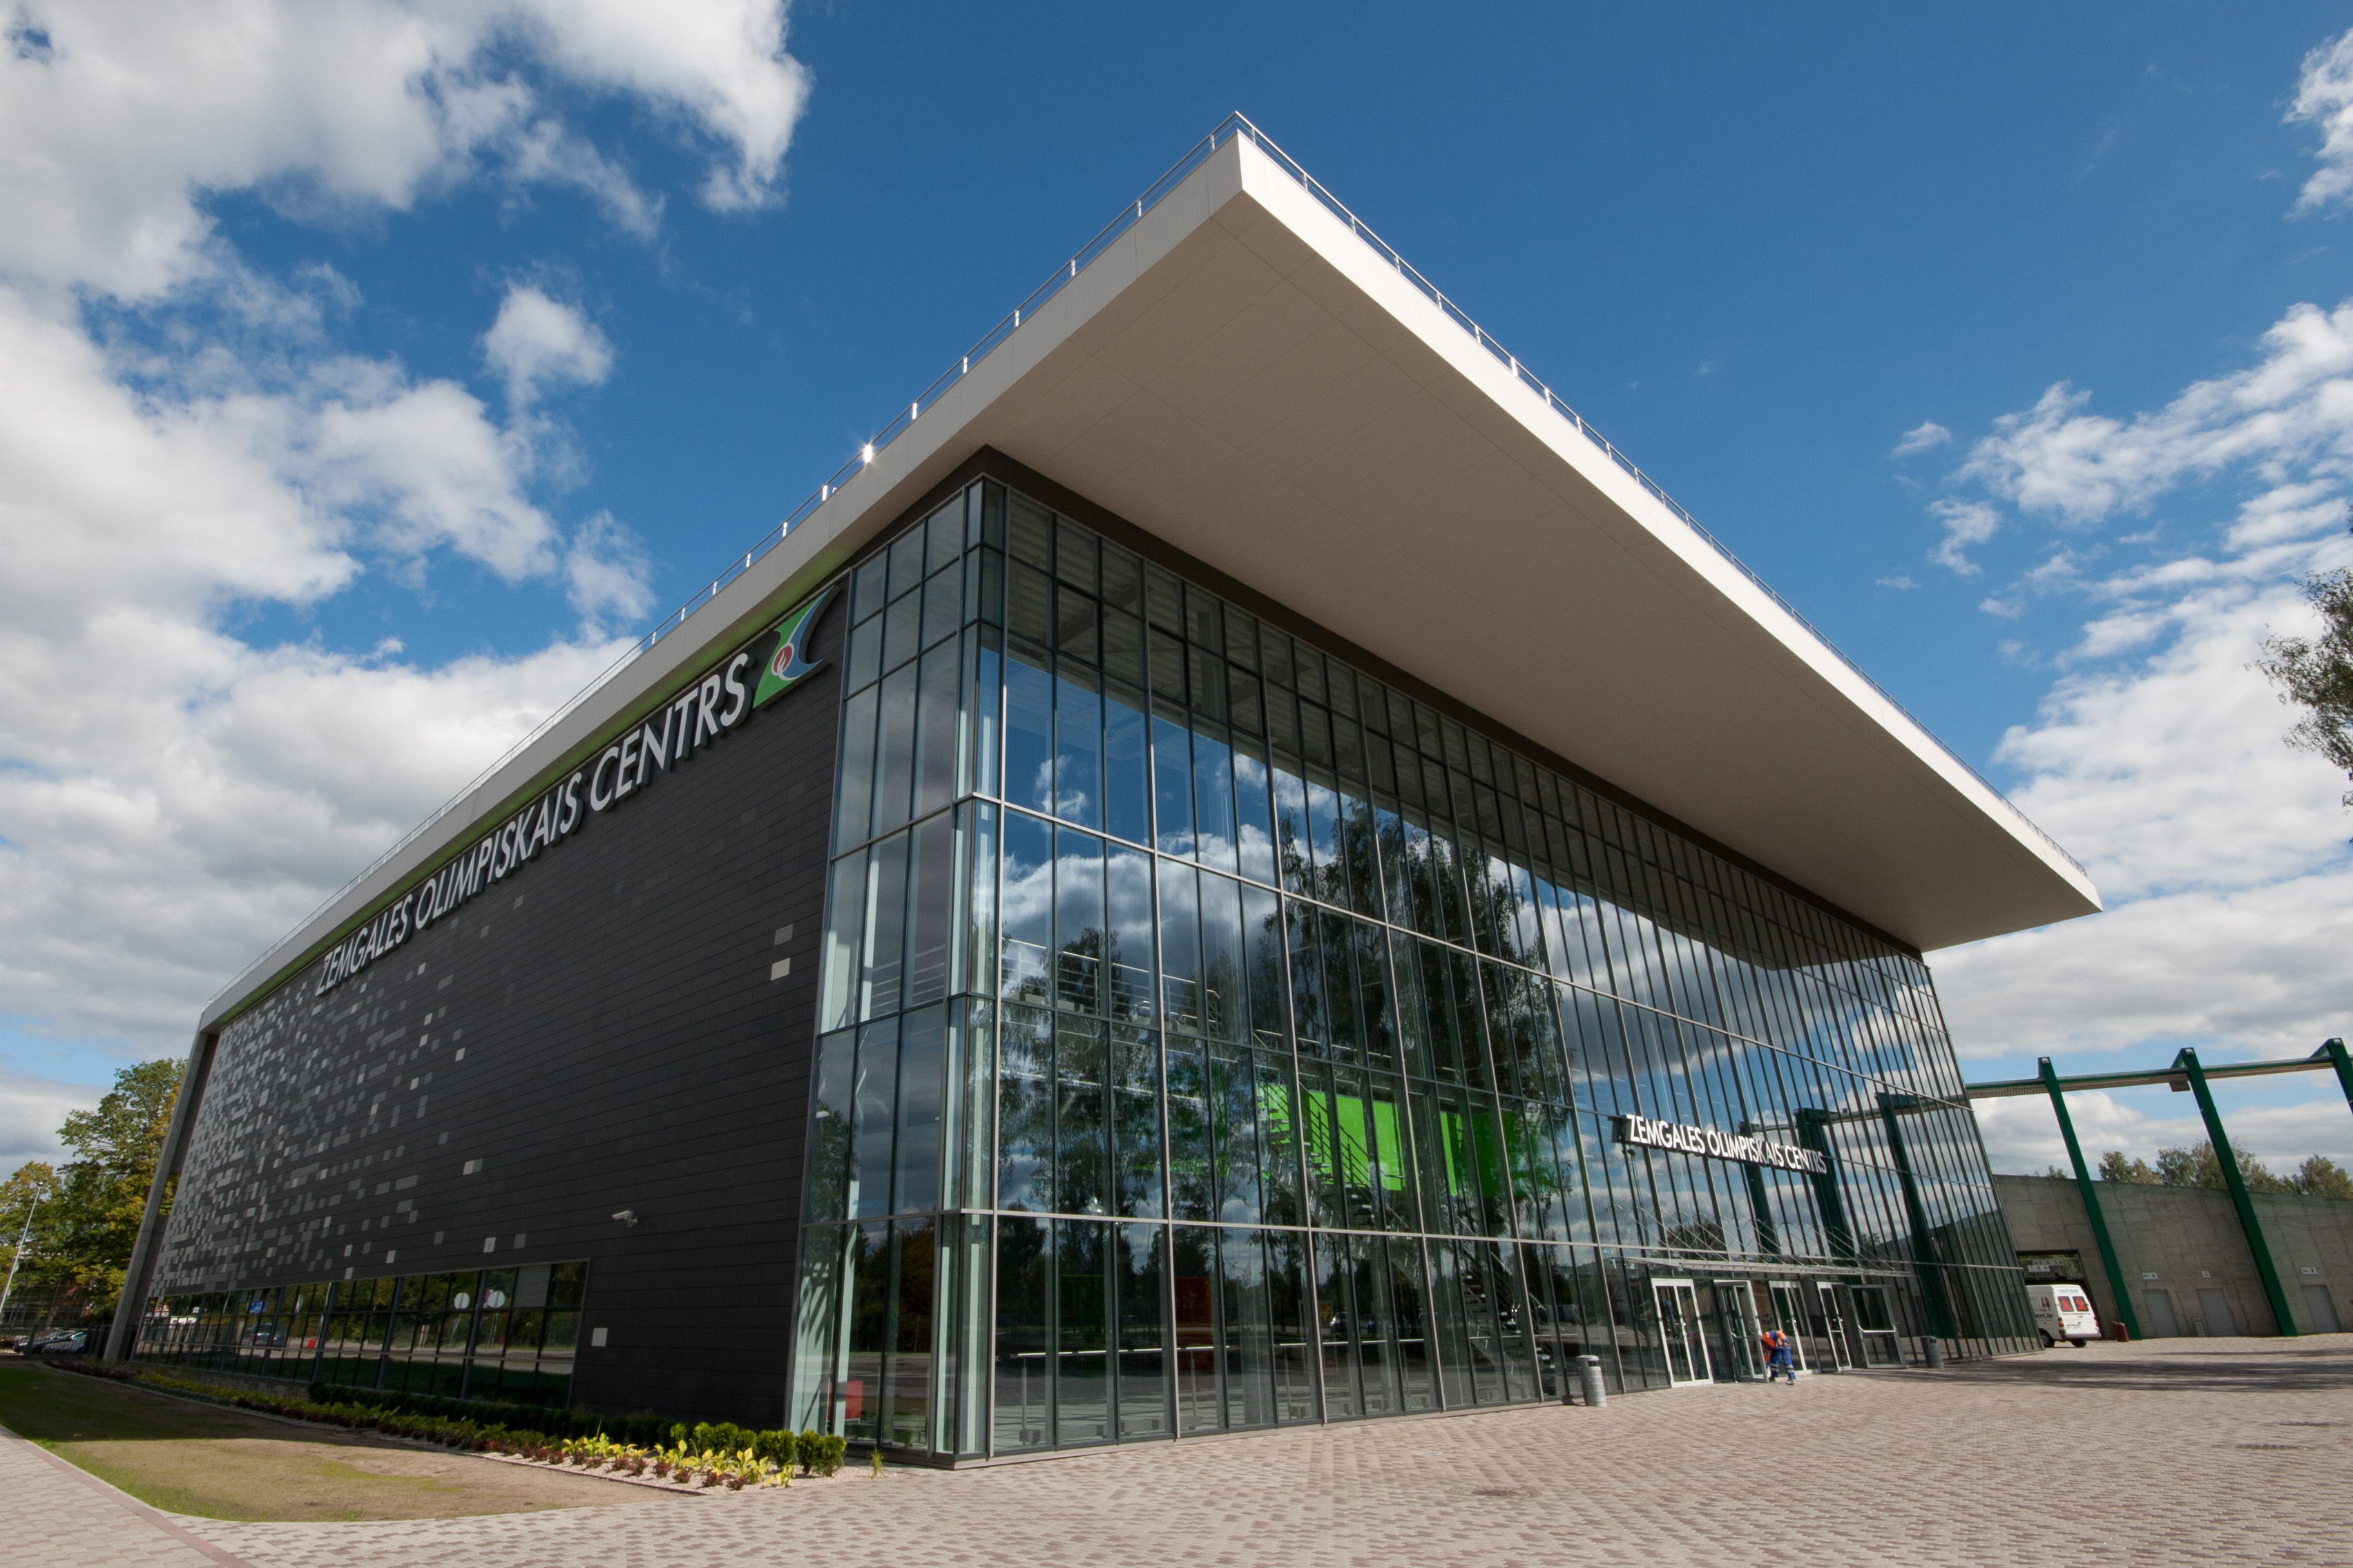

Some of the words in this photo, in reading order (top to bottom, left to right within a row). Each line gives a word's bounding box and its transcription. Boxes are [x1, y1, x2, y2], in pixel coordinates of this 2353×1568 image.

[315, 894, 413, 996] ZEMGALES
[415, 772, 582, 929] OLIMPISKAIS
[590, 653, 749, 811] CENTRS
[1626, 1114, 1706, 1154] ZEMGALES
[1707, 1130, 1785, 1168] OLIMPISKAIS
[1785, 1145, 1827, 1174] CENTRS
